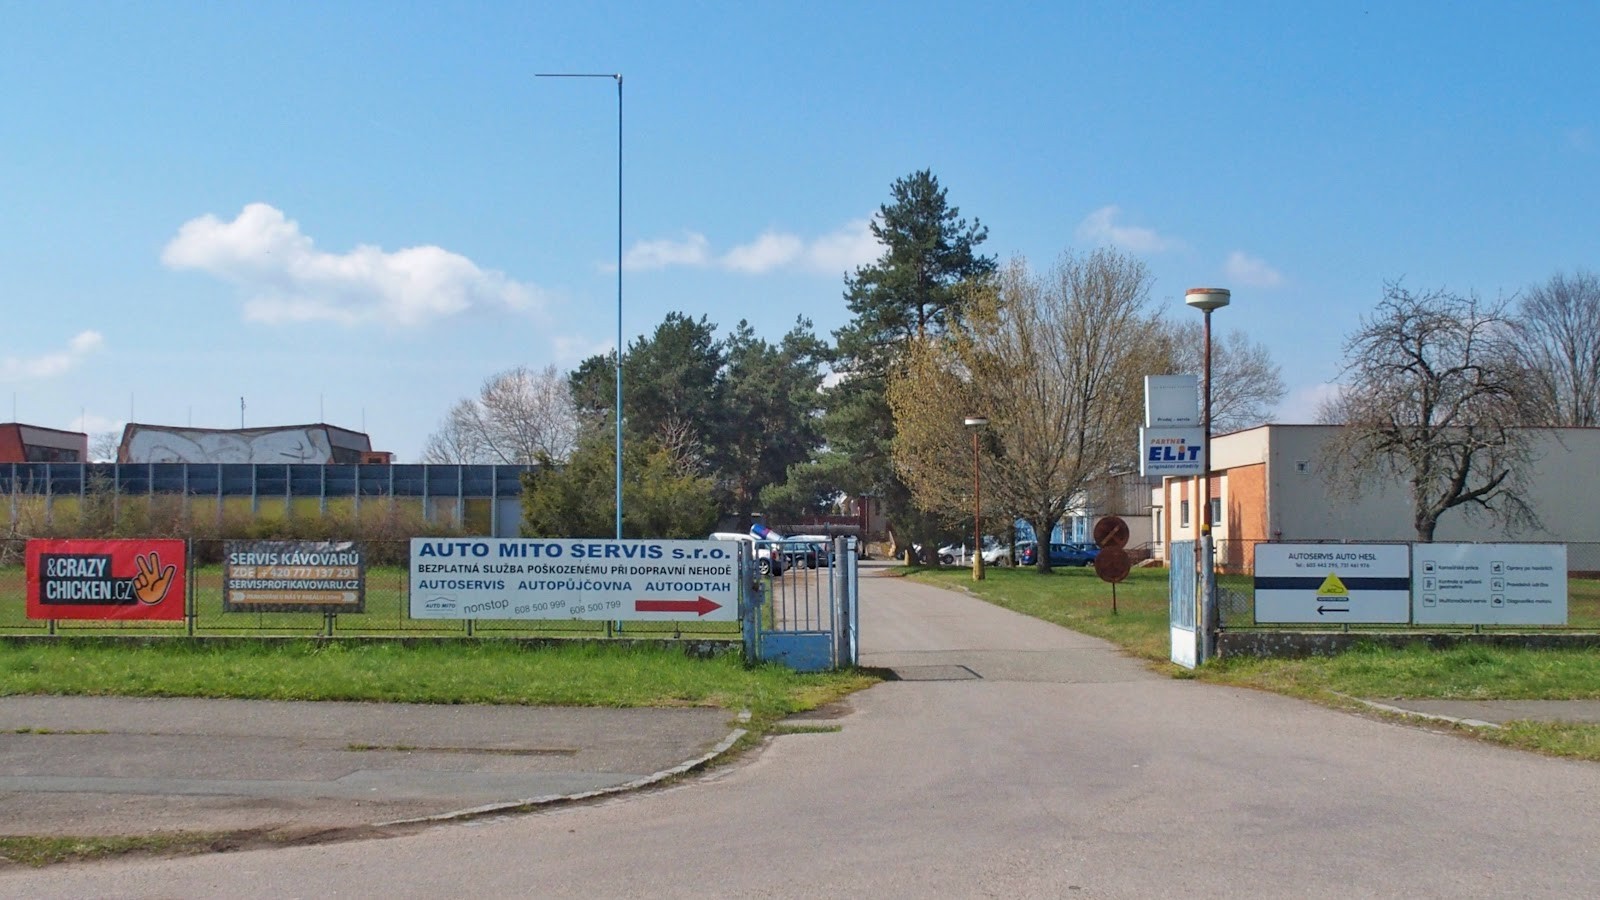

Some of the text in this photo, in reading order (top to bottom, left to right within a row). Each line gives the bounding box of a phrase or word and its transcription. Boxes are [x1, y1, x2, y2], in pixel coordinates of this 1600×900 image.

[230, 550, 359, 566] SERVIS KÁVOVARŮ
[420, 543, 731, 560] AUTO MITO SERVIS s.r.o.
[46, 558, 106, 578] &CRAZY
[232, 568, 254, 578] ZDE
[294, 568, 312, 578] 777
[316, 568, 333, 578] 137
[336, 568, 356, 578] 291
[418, 562, 732, 576] BEZPLATNÁ SLUŽBA POŠKOZENÉMU PŘI DOPRAVNÍ NEHODĚ
[46, 581, 132, 600] CHICKEN.CZ
[419, 578, 731, 592] AUTOSERVIS AUTOPŮJČOVNA AUTOODTAH
[464, 598, 622, 615] nonstop 608 500 999 608 500 799
